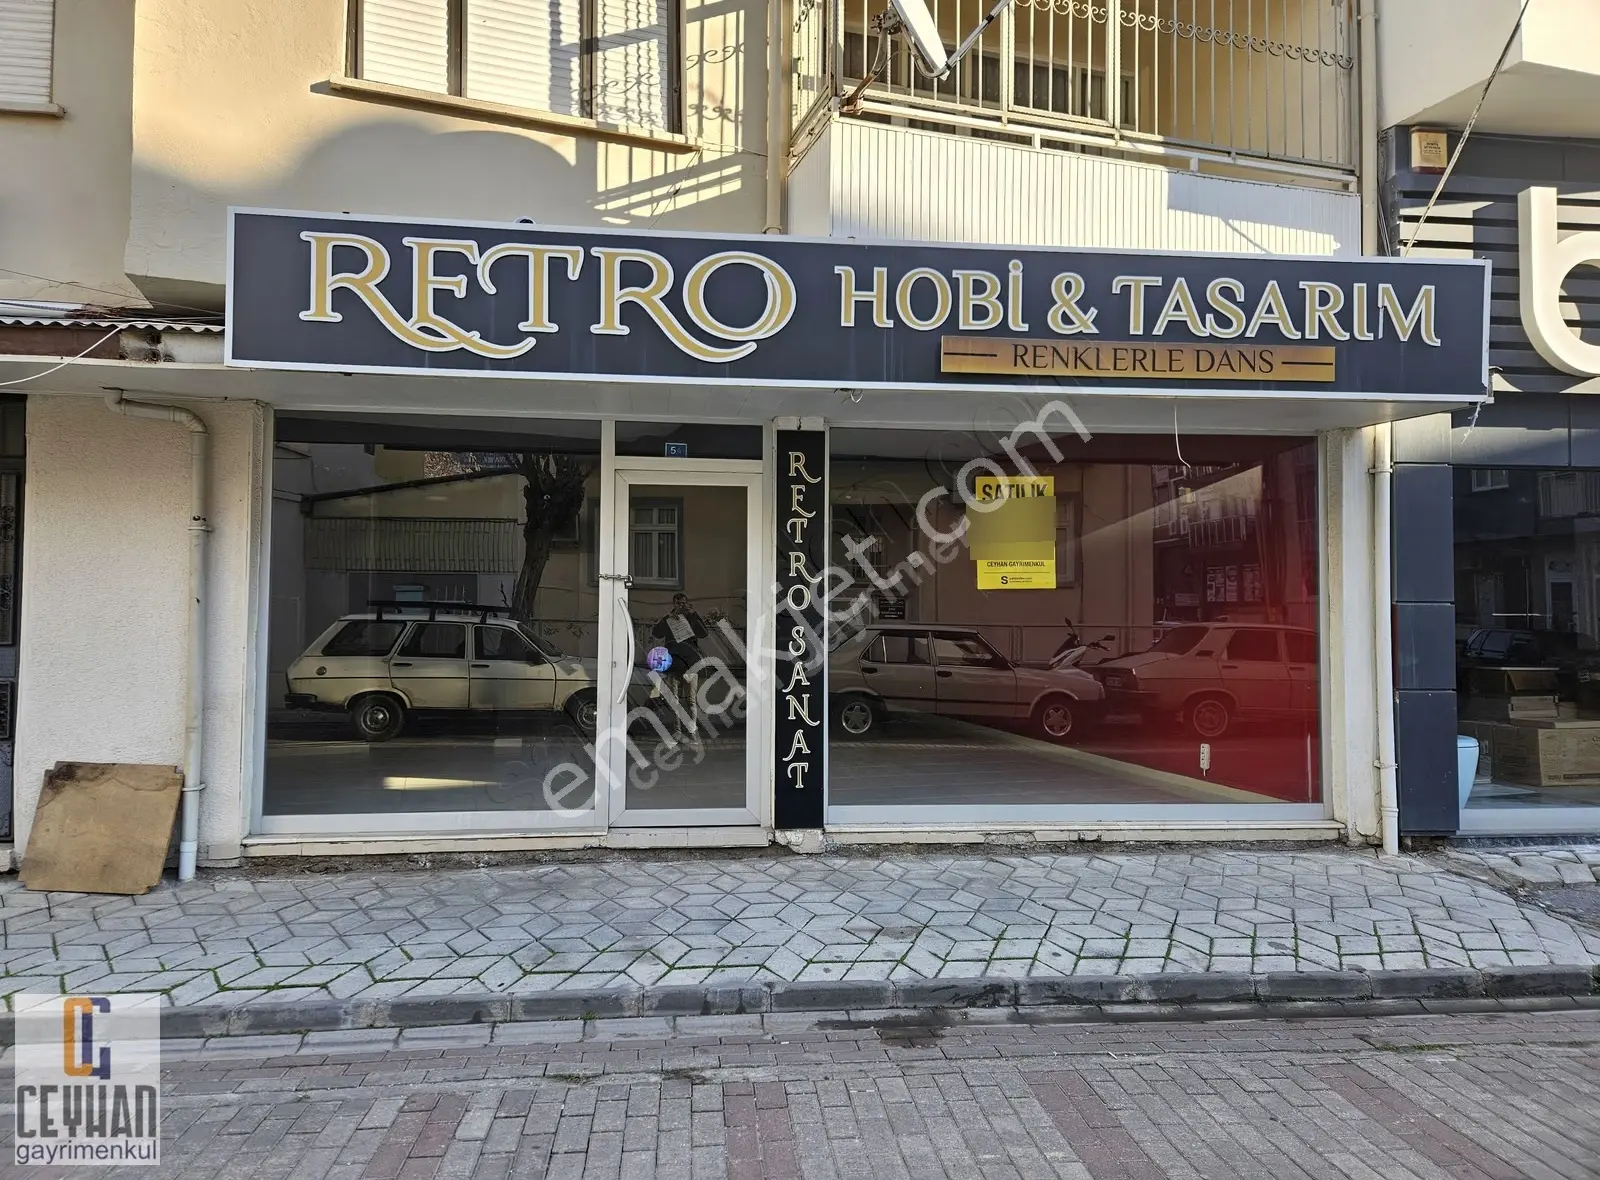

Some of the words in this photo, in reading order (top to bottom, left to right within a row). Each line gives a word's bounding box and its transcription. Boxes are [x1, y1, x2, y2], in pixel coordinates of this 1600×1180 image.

[298, 230, 797, 364] RETRO
[835, 259, 1030, 333] HOBİ
[1047, 272, 1099, 335] &
[1112, 275, 1442, 347] TASARIM
[1012, 344, 1185, 373] RENKLERLE
[1195, 348, 1275, 375] DANS
